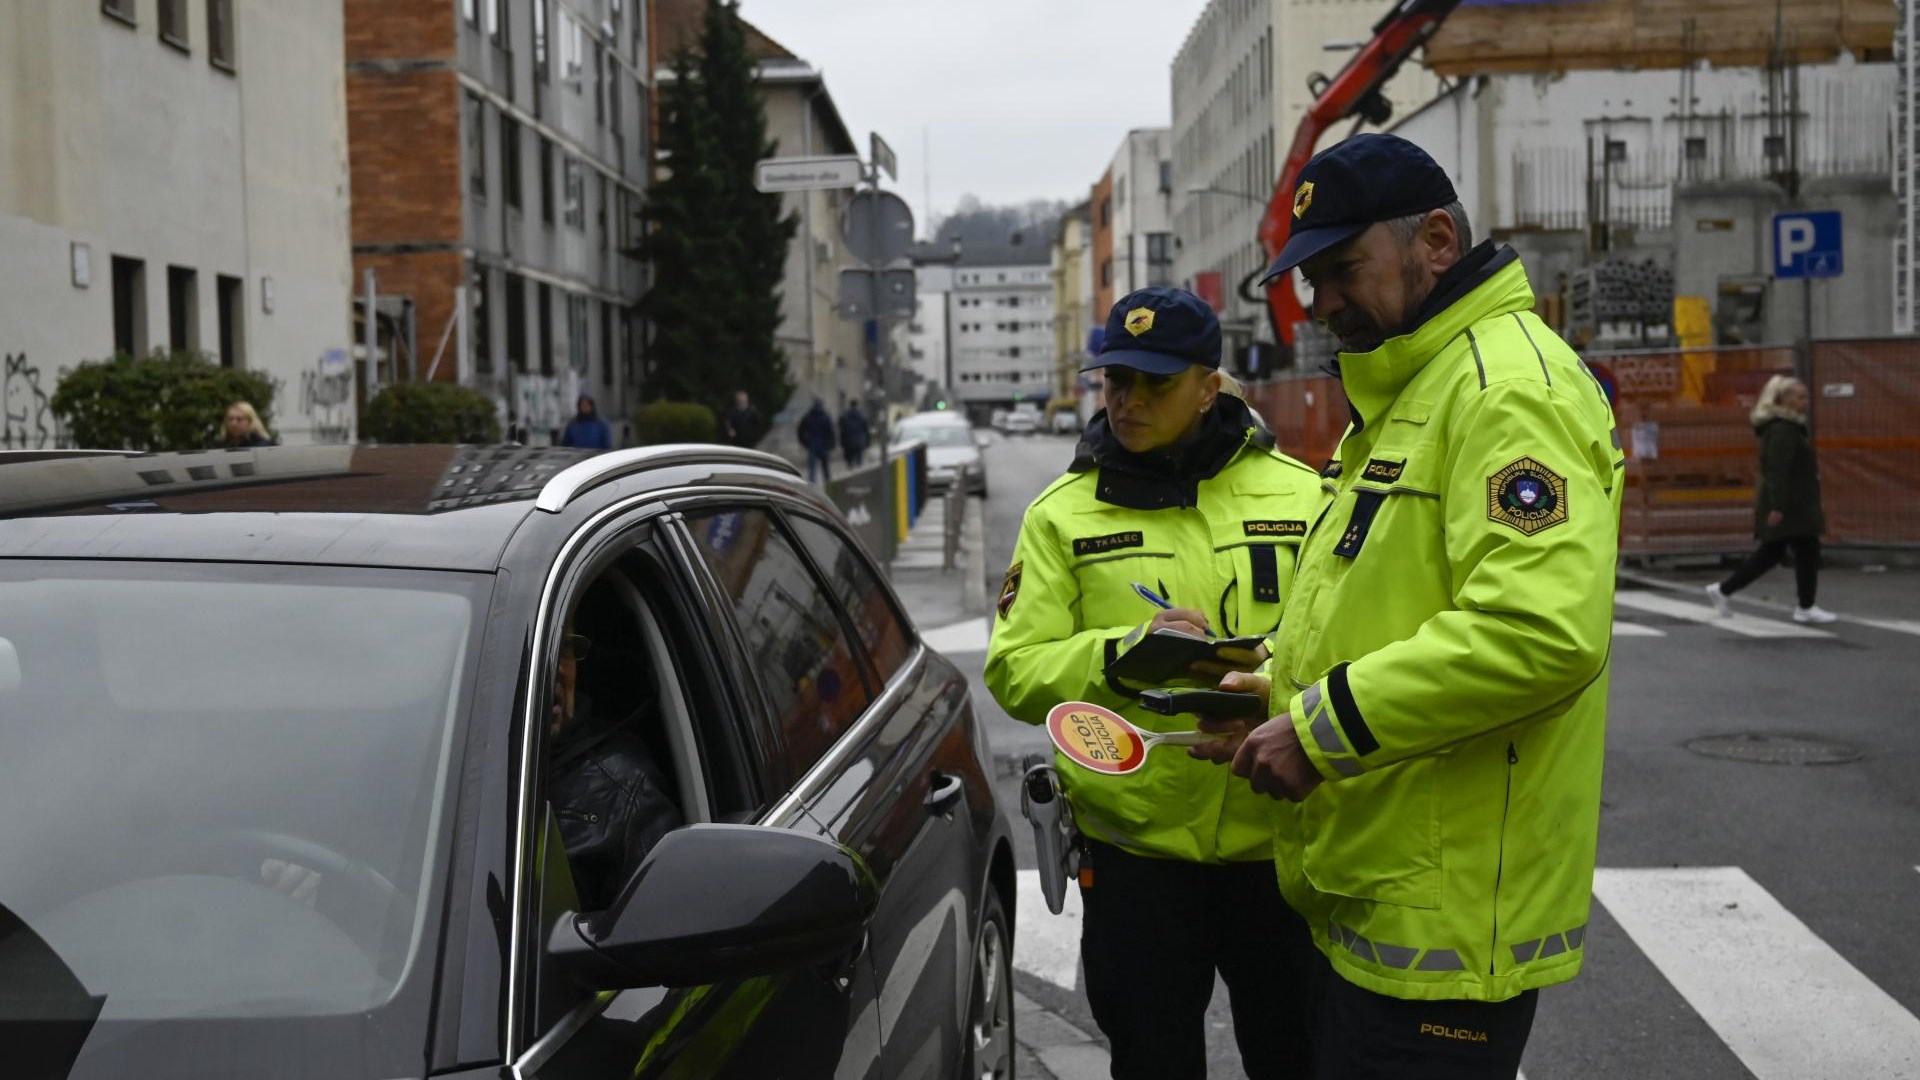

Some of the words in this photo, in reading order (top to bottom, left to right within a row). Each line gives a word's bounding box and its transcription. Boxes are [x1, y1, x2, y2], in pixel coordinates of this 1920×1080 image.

[1778, 218, 1816, 267] P
[1499, 470, 1526, 495] REPUBLIKA
[1529, 470, 1556, 496] SLOVENIJA
[1507, 506, 1551, 520] POLICIJA
[1247, 523, 1304, 532] POLICIJA
[1095, 534, 1139, 547] TKALEC
[1070, 714, 1104, 760] STOP
[1089, 715, 1123, 760] POLICIJA
[1420, 1022, 1488, 1042] POLICIJA
